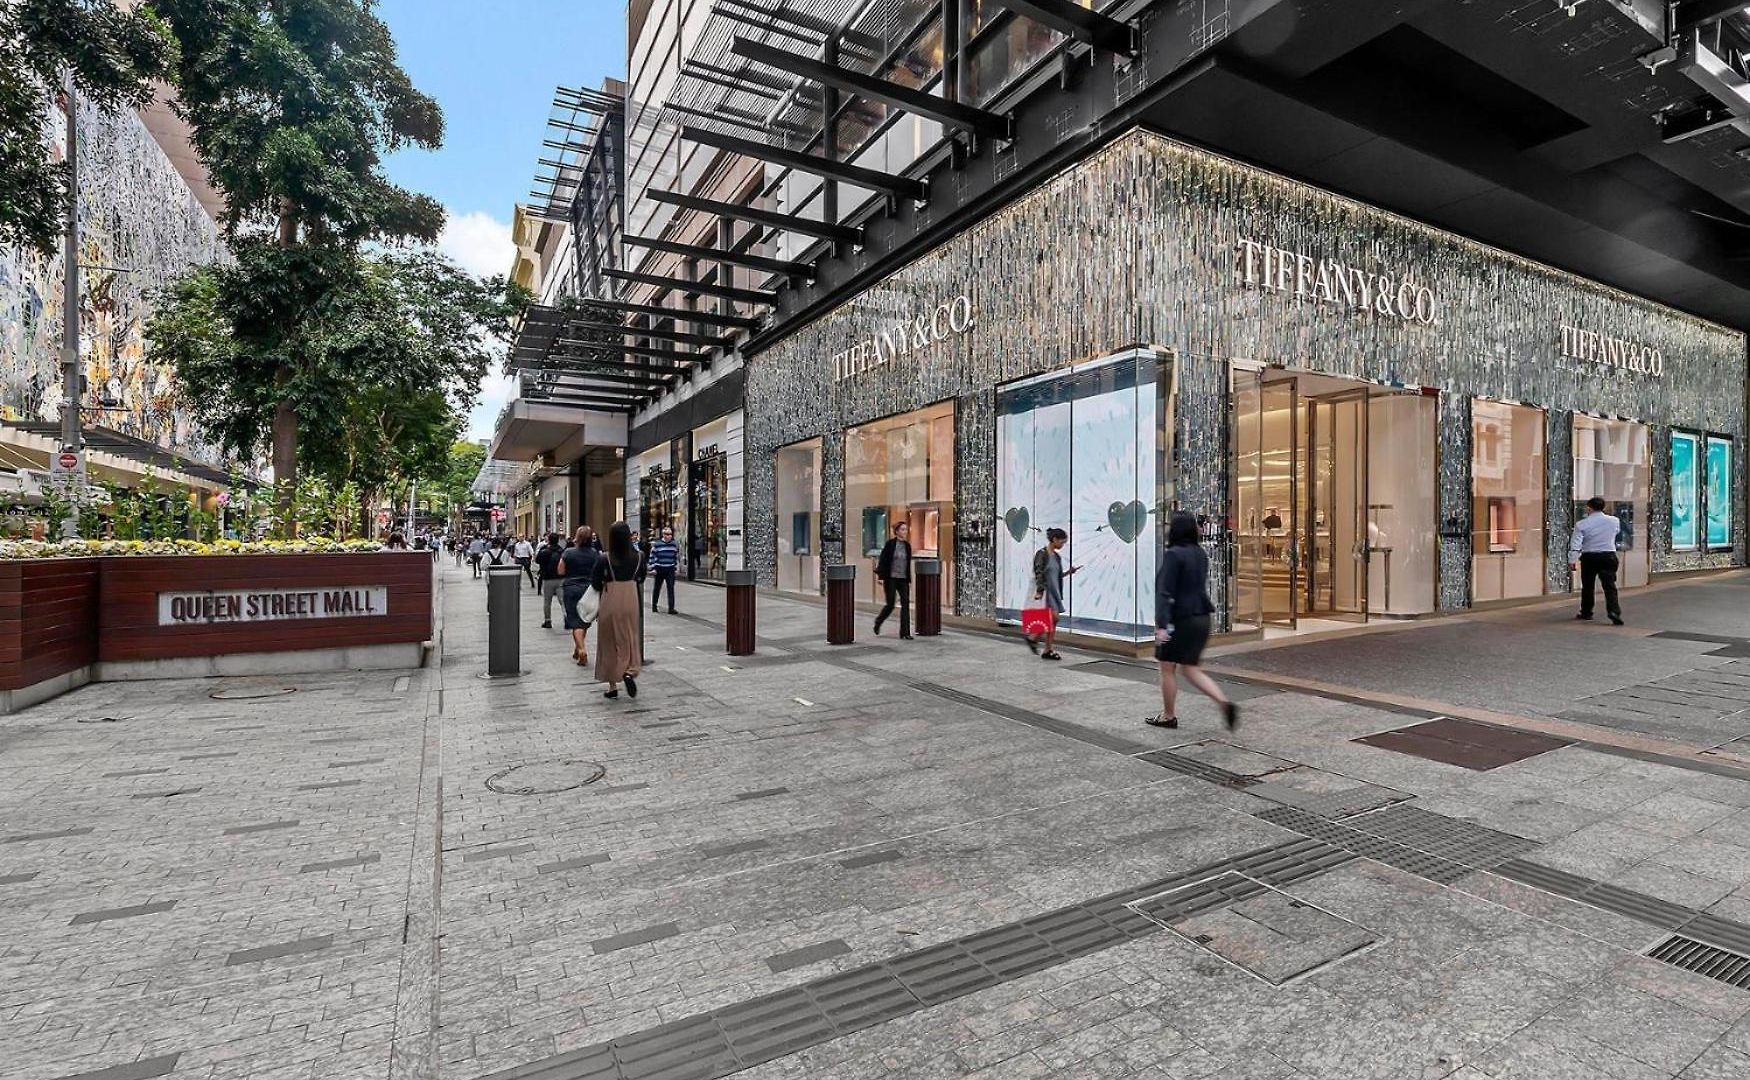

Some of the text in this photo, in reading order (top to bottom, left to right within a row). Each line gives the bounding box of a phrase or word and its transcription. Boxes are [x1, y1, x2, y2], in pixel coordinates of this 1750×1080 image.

[171, 590, 375, 621] QUEEN STREET MALL
